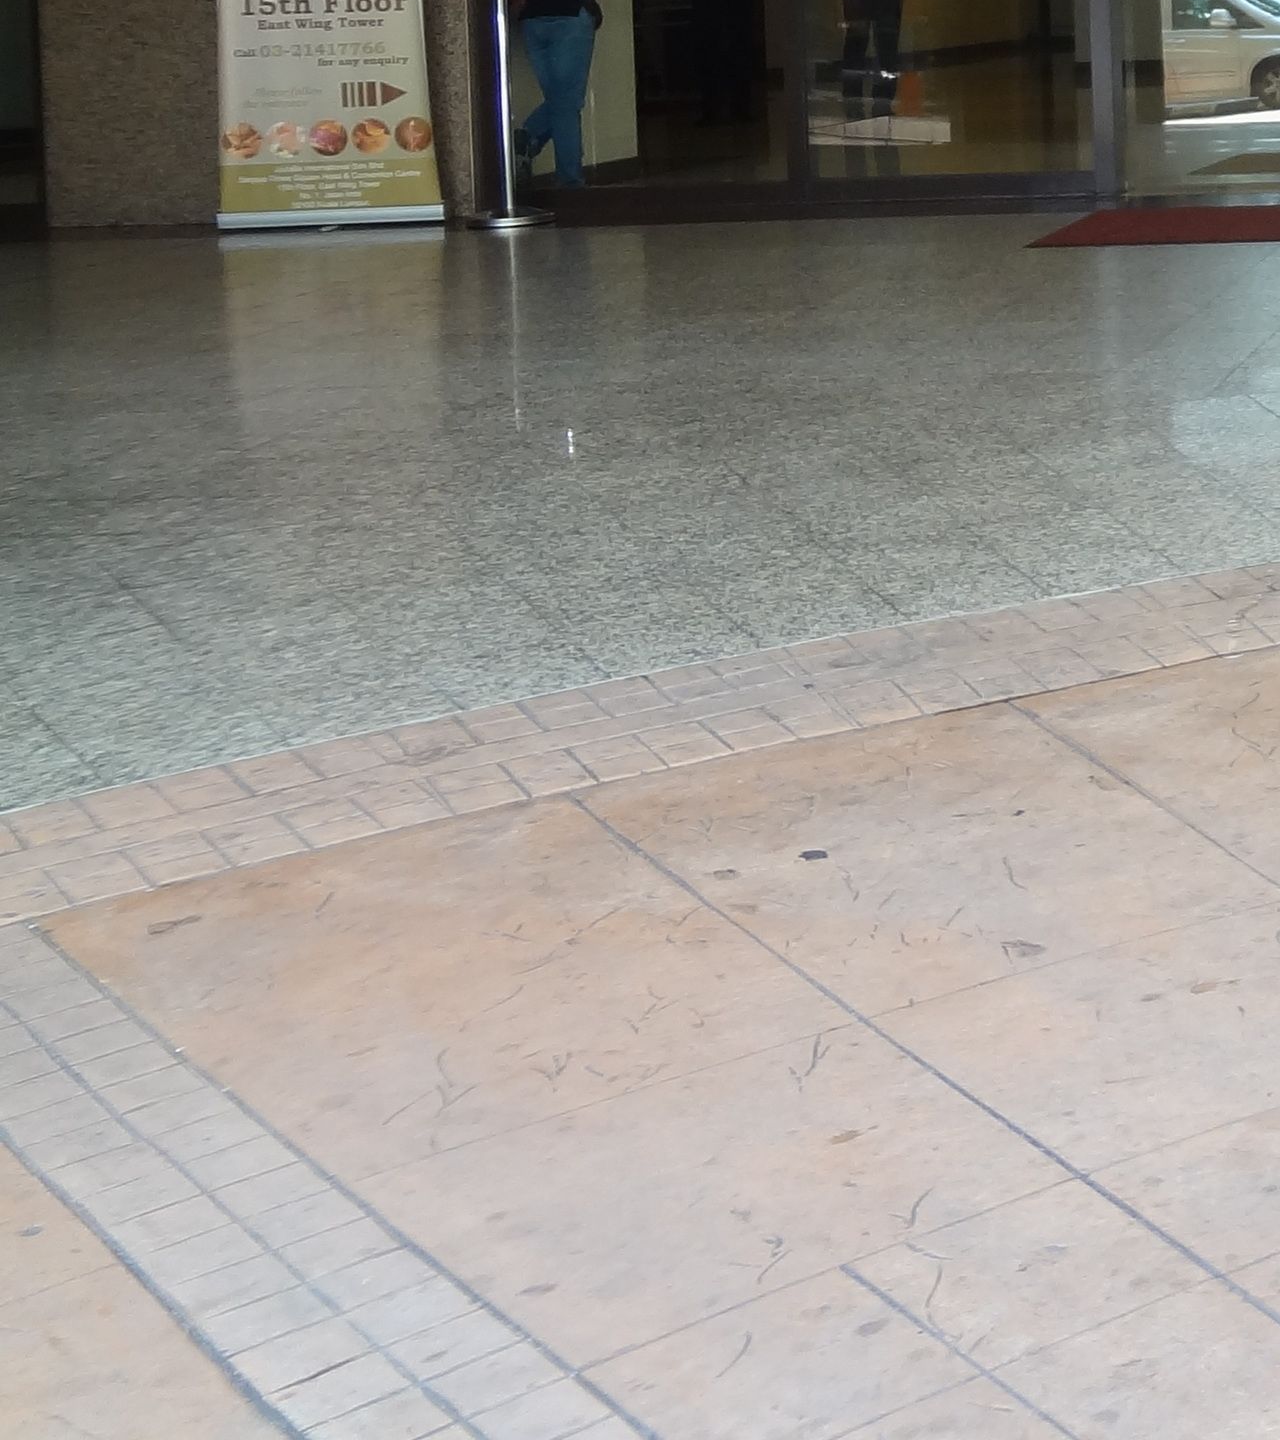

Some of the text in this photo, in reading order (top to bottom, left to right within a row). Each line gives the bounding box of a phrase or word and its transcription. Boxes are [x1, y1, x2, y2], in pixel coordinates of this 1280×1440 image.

[257, 17, 385, 31] East Wing Tower
[260, 41, 386, 58] 03-21417766
[317, 56, 409, 67] for any enquiry
